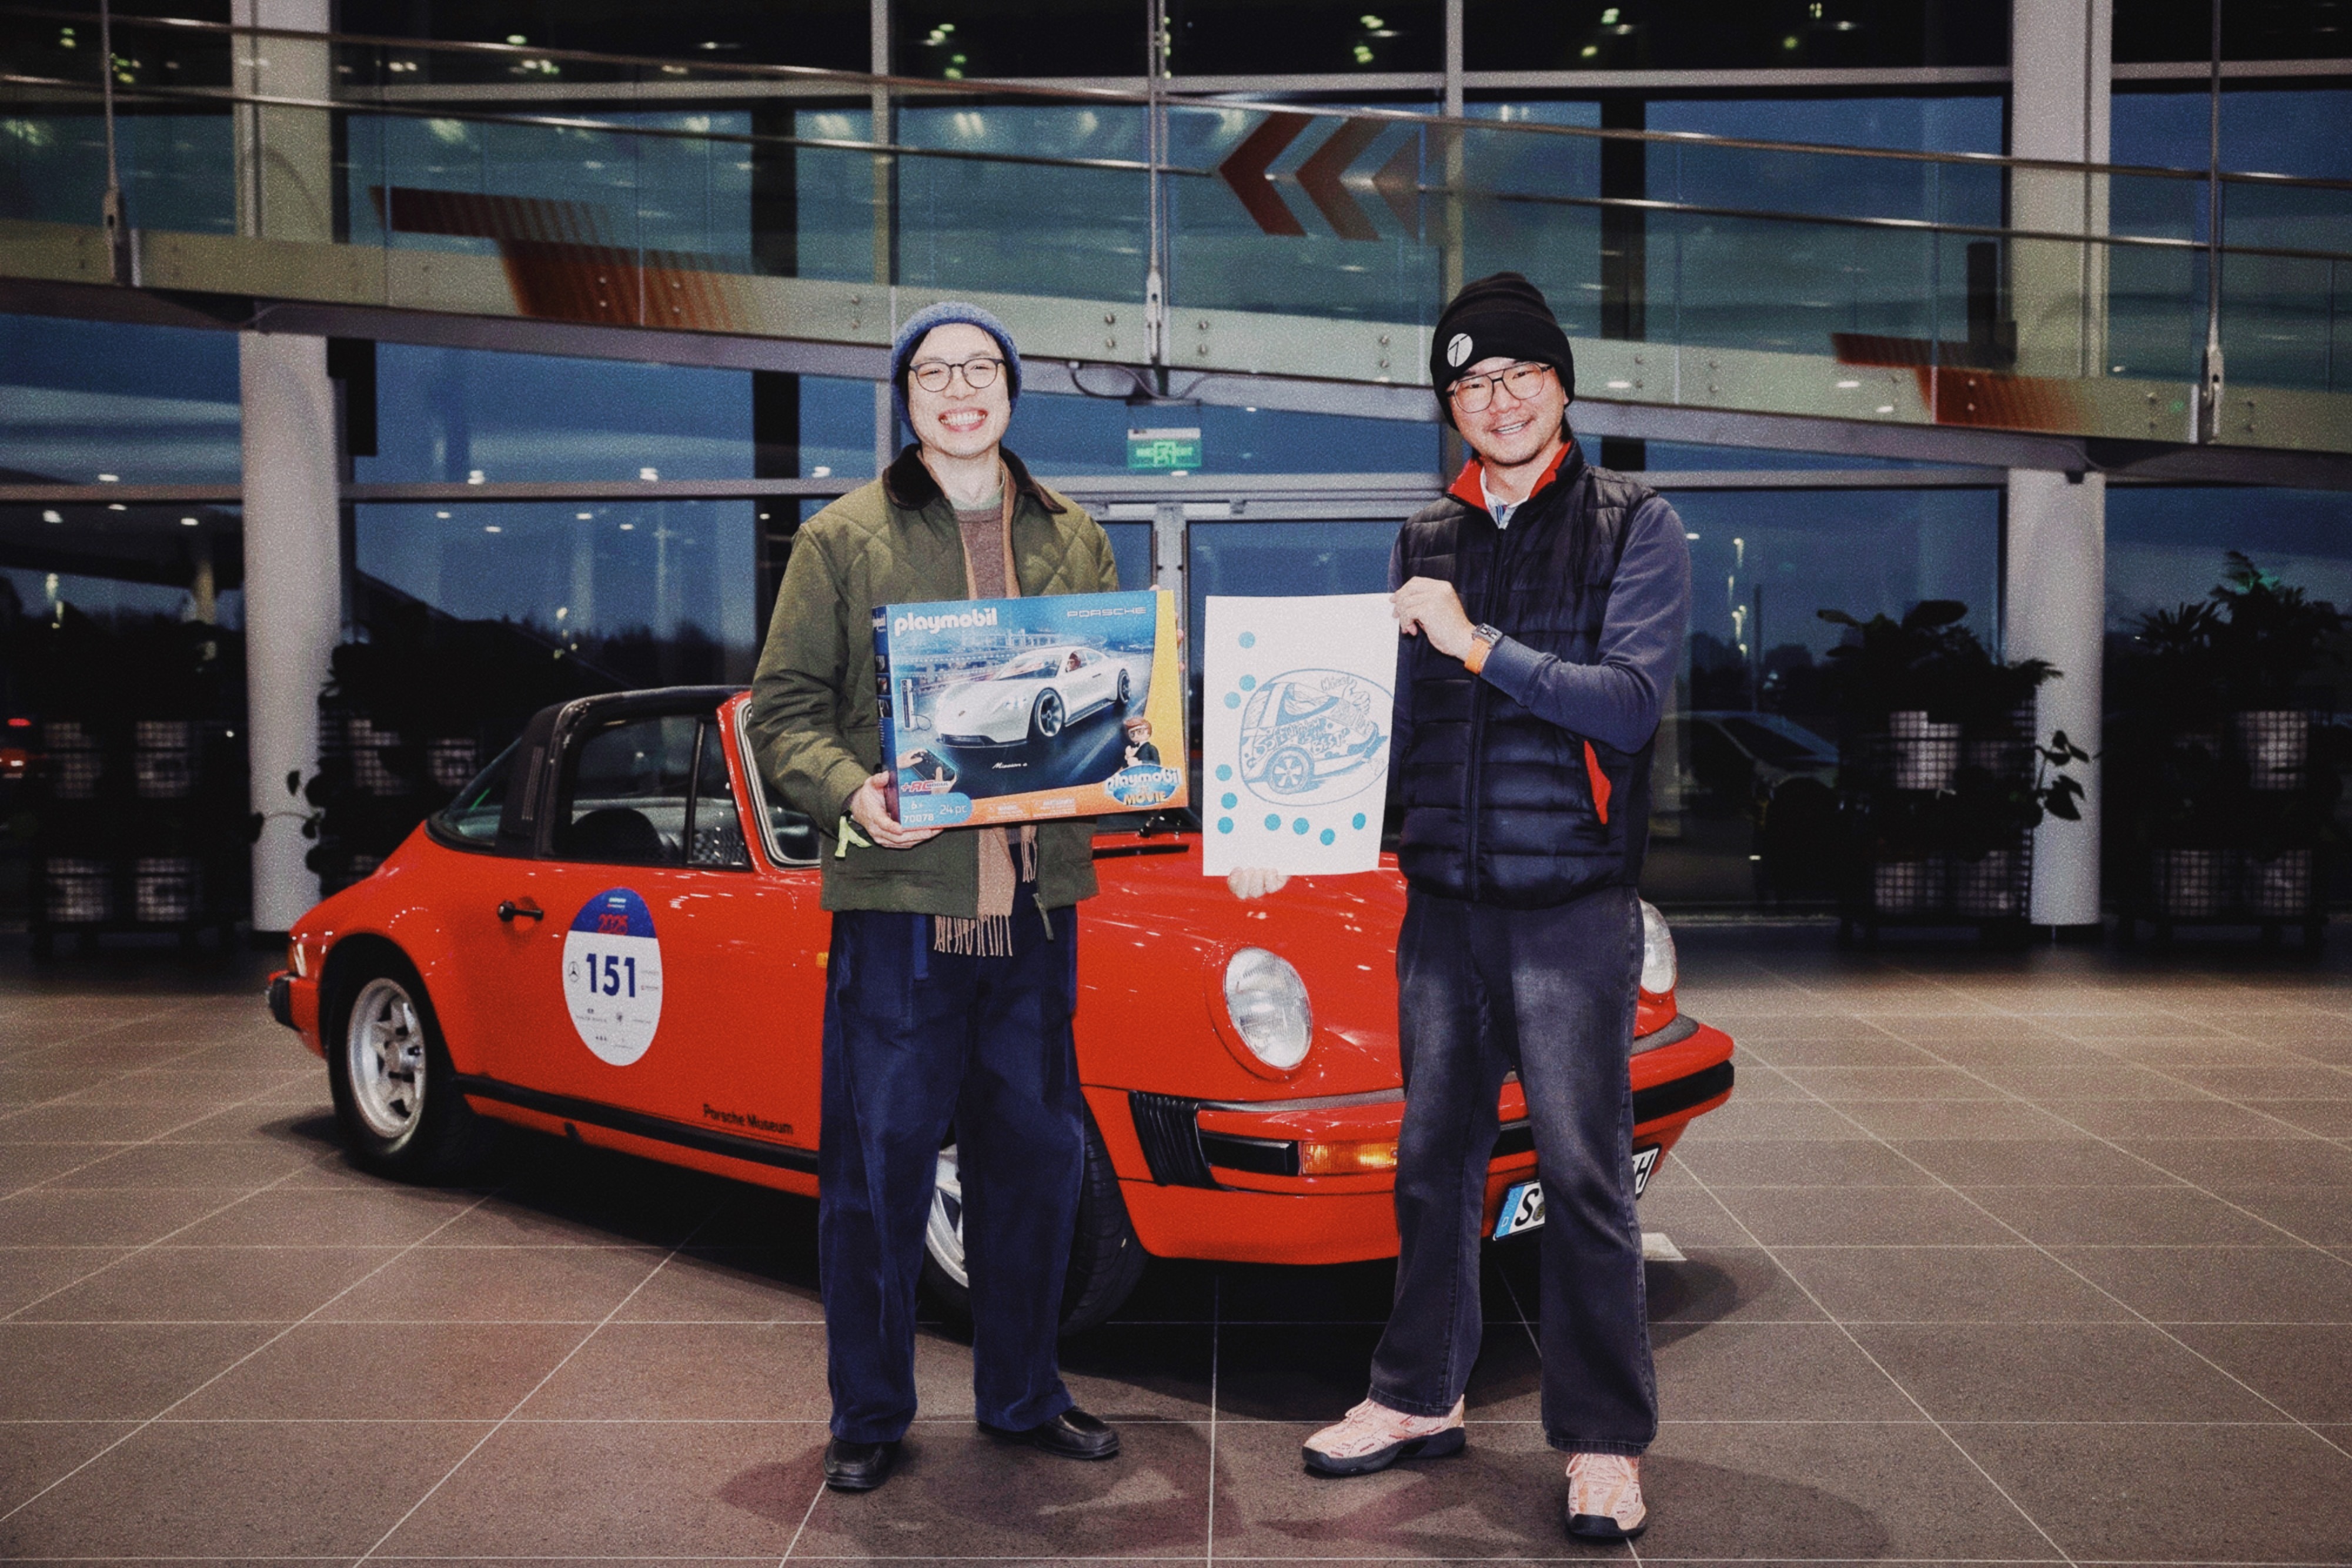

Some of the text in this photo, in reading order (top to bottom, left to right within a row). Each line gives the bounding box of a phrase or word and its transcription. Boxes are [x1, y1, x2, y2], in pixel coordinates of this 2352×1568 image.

[894, 607, 998, 637] playmobil
[1067, 607, 1147, 618] PORSCHE
[1106, 768, 1183, 794] playmobil
[1123, 791, 1167, 805] MOVIE
[903, 813, 934, 823] 70078
[940, 804, 967, 815] 24 pc
[586, 952, 636, 998] 151
[703, 1104, 793, 1134] Porsche Museum
[1515, 1188, 1539, 1226] S
[1501, 1216, 1509, 1227] D
